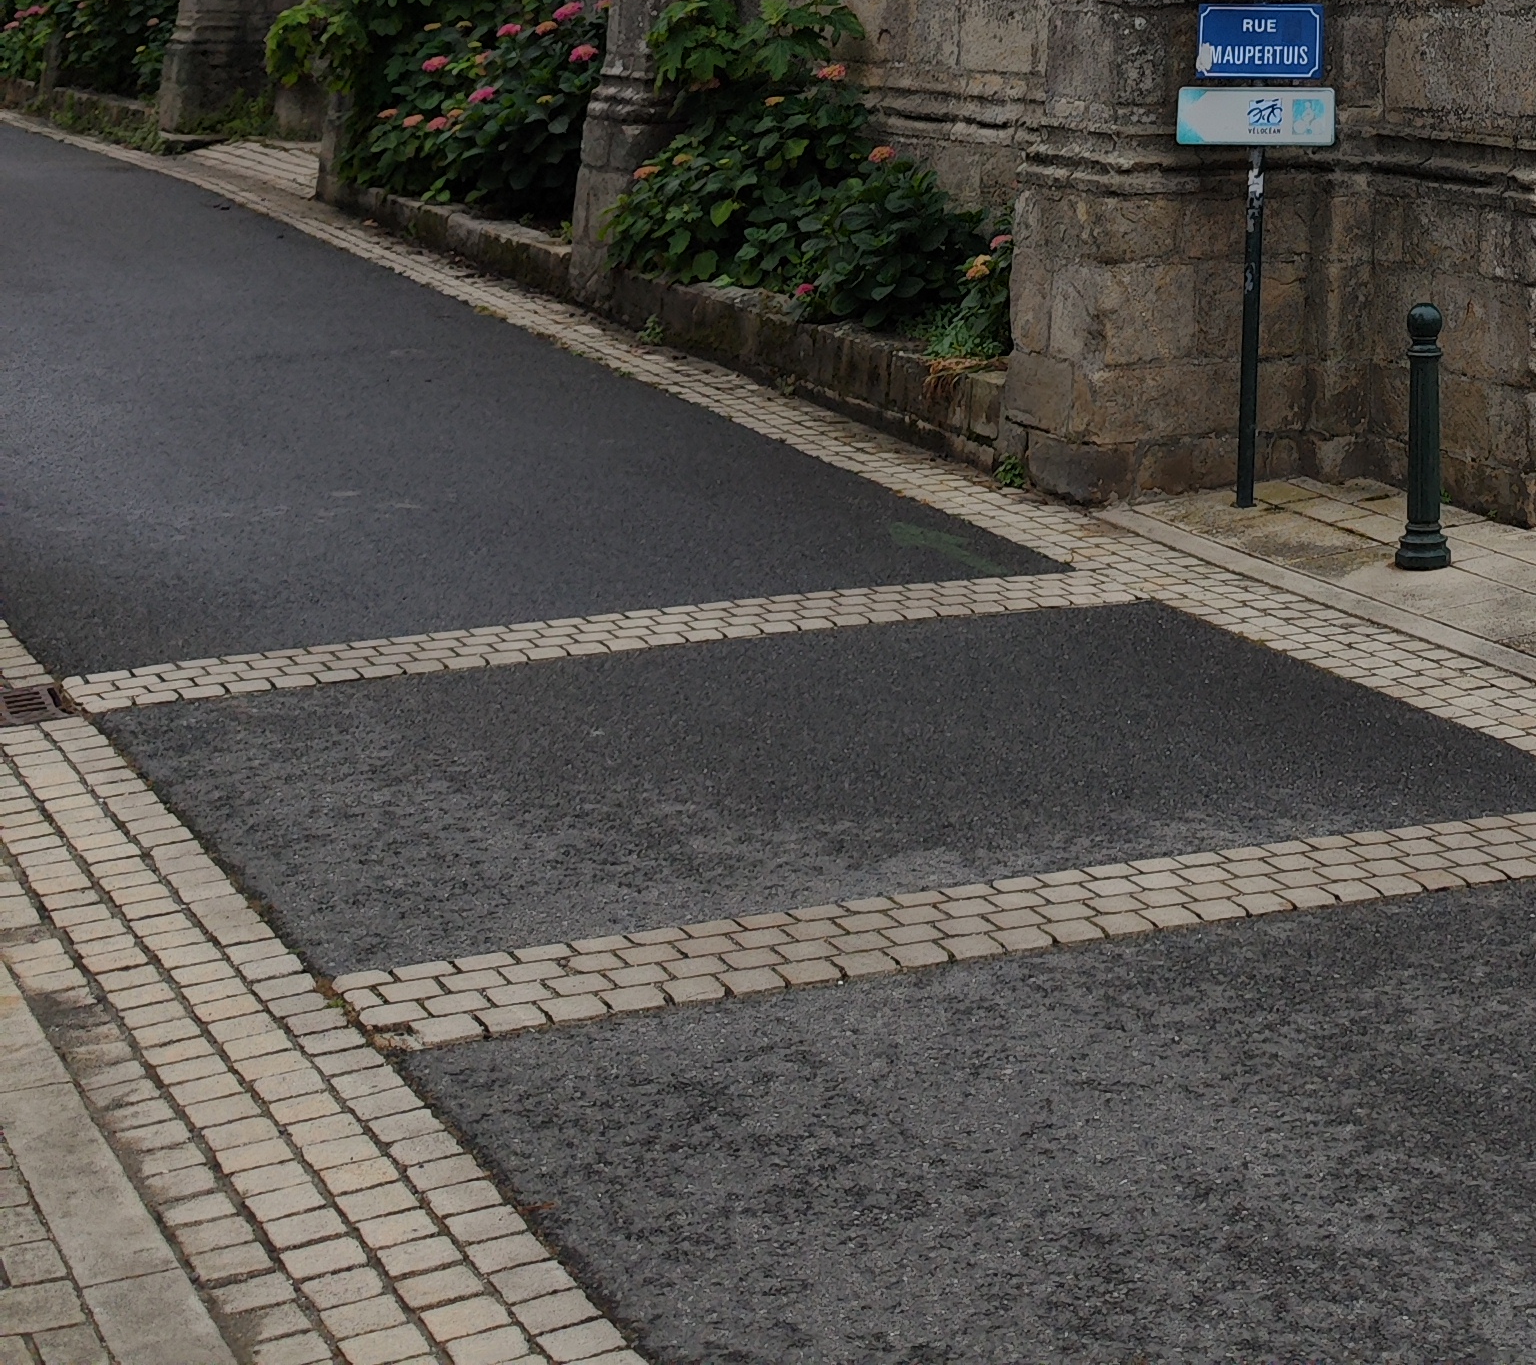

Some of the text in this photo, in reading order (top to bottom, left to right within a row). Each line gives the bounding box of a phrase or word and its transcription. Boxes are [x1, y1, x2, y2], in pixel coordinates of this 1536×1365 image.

[1242, 18, 1277, 33] RUE
[1210, 45, 1309, 65] MAUPERTUIS
[1247, 126, 1282, 135] VÉLOCÉAN
